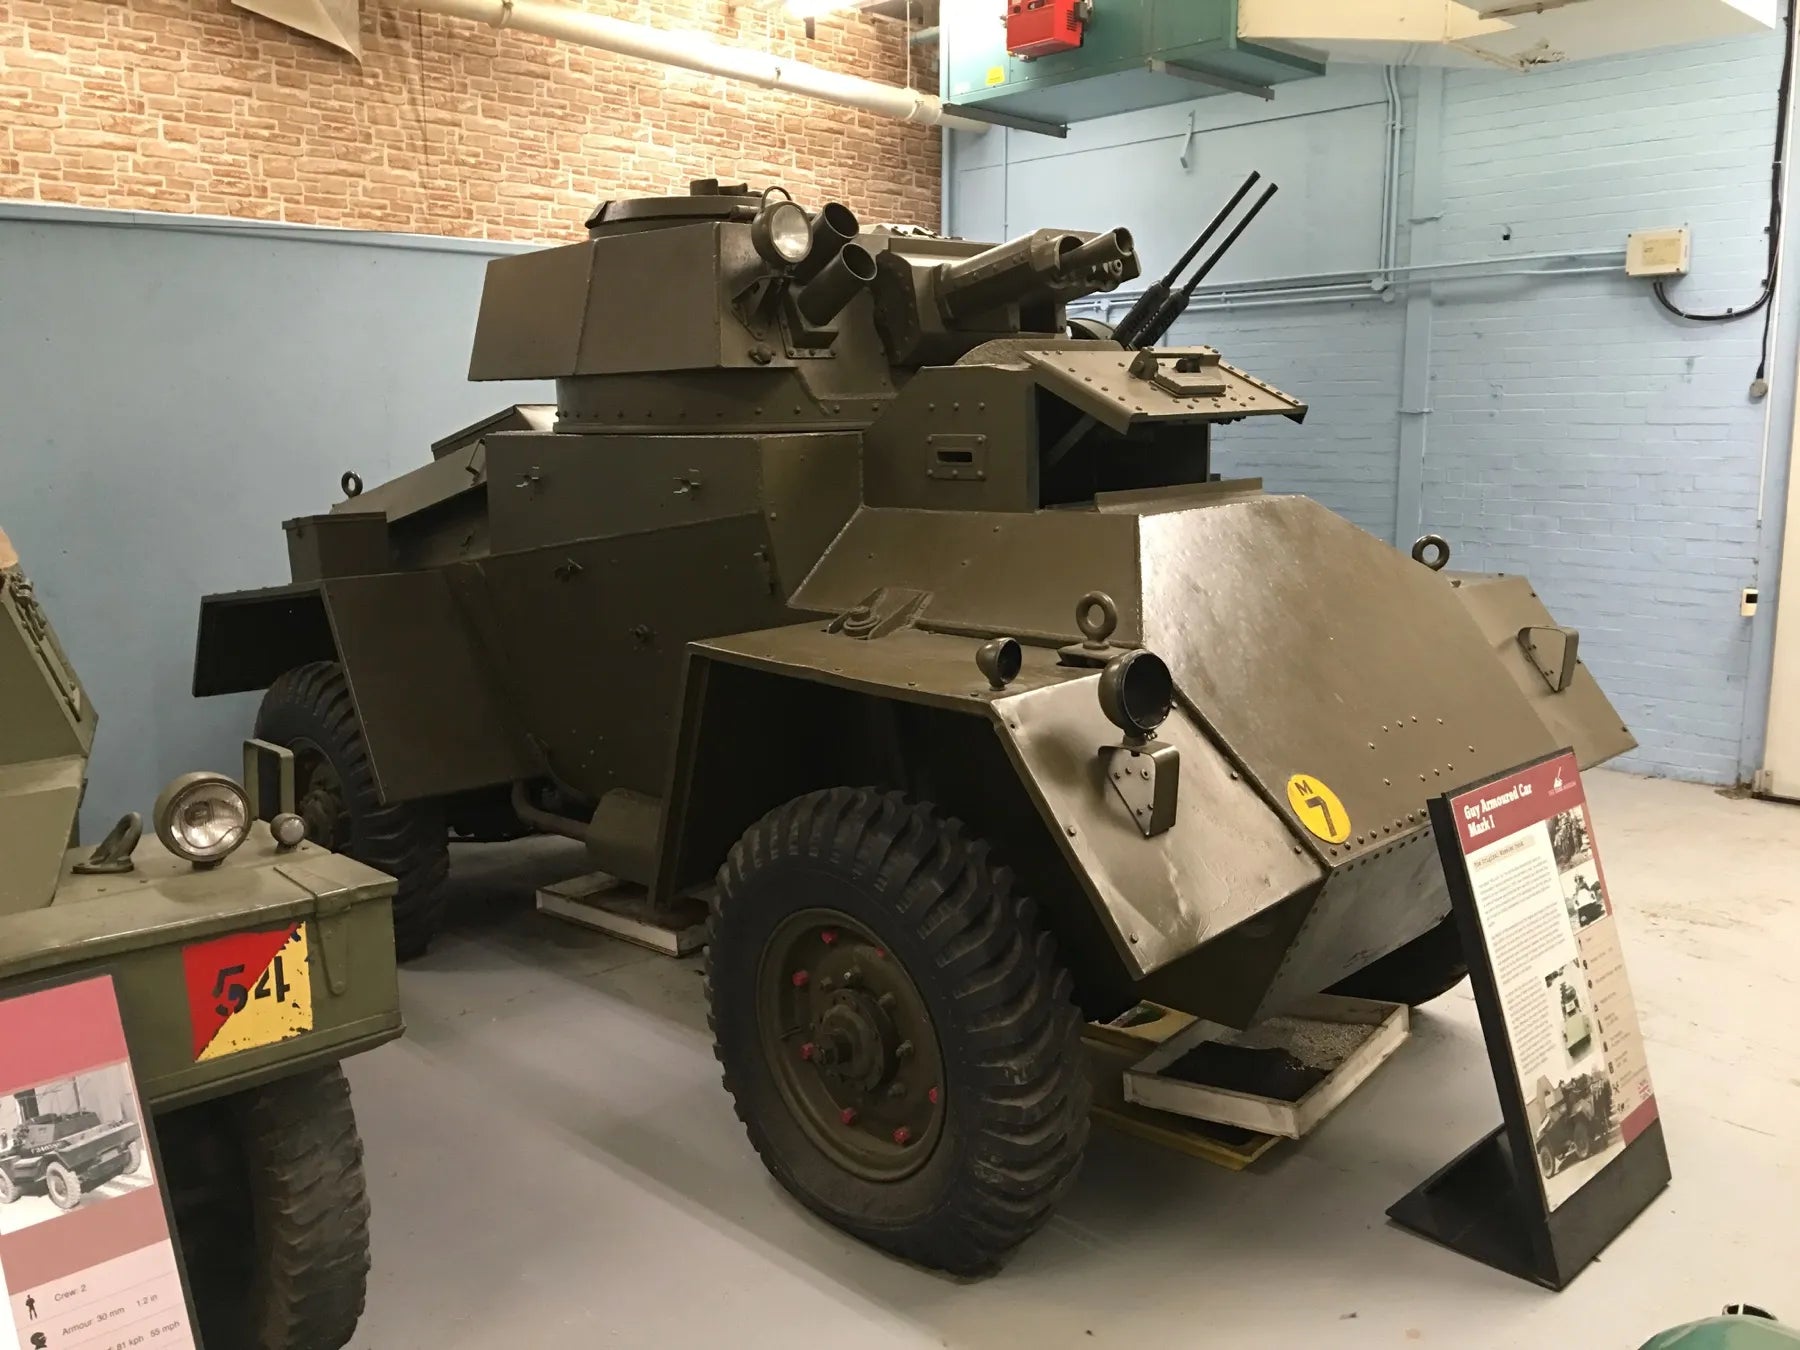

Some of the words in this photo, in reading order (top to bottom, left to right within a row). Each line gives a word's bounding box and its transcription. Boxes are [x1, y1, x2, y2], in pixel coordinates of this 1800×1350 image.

[1294, 779, 1313, 796] M
[1463, 804, 1480, 820] Guy
[1480, 785, 1519, 813] Armoured
[1518, 783, 1532, 797] Car
[1305, 795, 1337, 837] 7
[1467, 816, 1490, 838] Mark
[211, 955, 290, 1017] 54
[81, 1284, 87, 1292] 2
[97, 1312, 107, 1322] 30
[109, 1307, 125, 1317] mm
[137, 1296, 148, 1307] 1.2
[150, 1294, 158, 1302] in
[128, 1335, 144, 1346] kph
[150, 1327, 160, 1338] 55
[162, 1320, 180, 1333] mph
